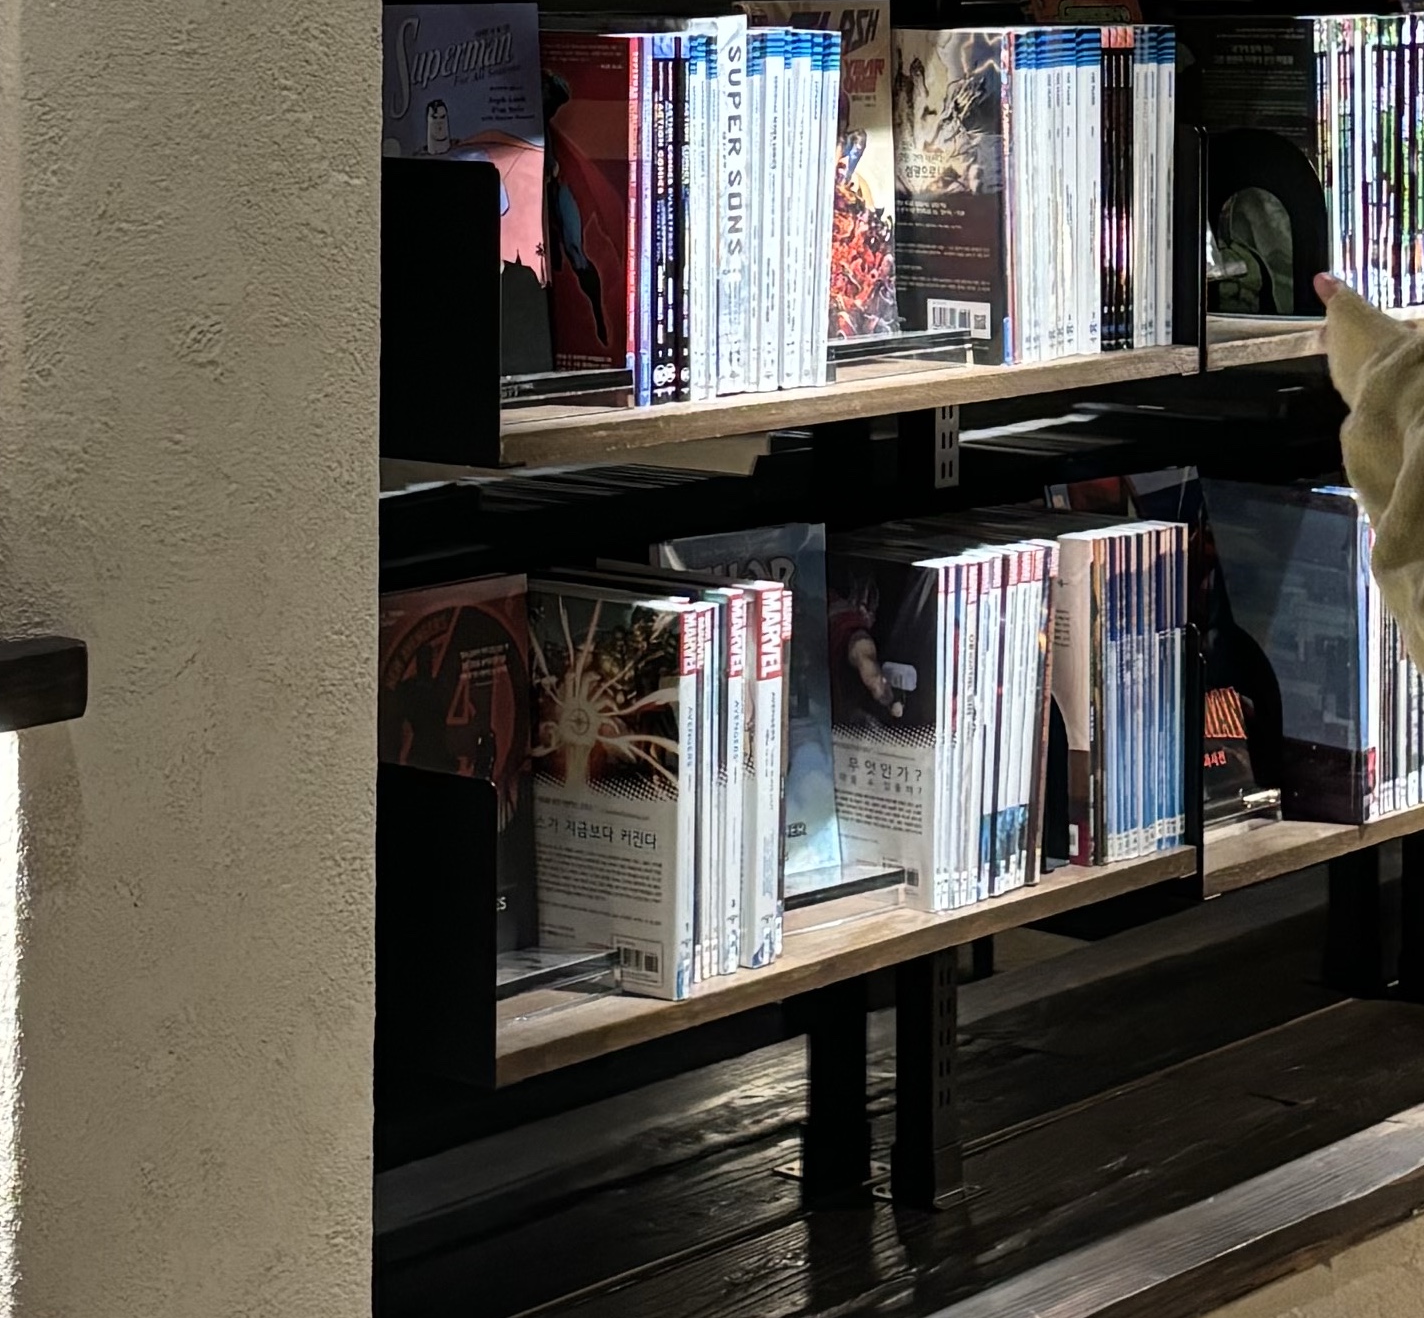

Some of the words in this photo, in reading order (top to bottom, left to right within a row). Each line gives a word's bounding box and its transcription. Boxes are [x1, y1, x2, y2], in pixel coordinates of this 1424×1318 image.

[390, 17, 513, 120] Superman
[727, 44, 744, 156] SUPER
[727, 169, 745, 258] SONS
[683, 612, 697, 675] MARVEL
[730, 598, 747, 676] MARVEL
[760, 589, 781, 679] MARVEL
[566, 819, 613, 843] 지금보다
[621, 828, 657, 850] 커진다
